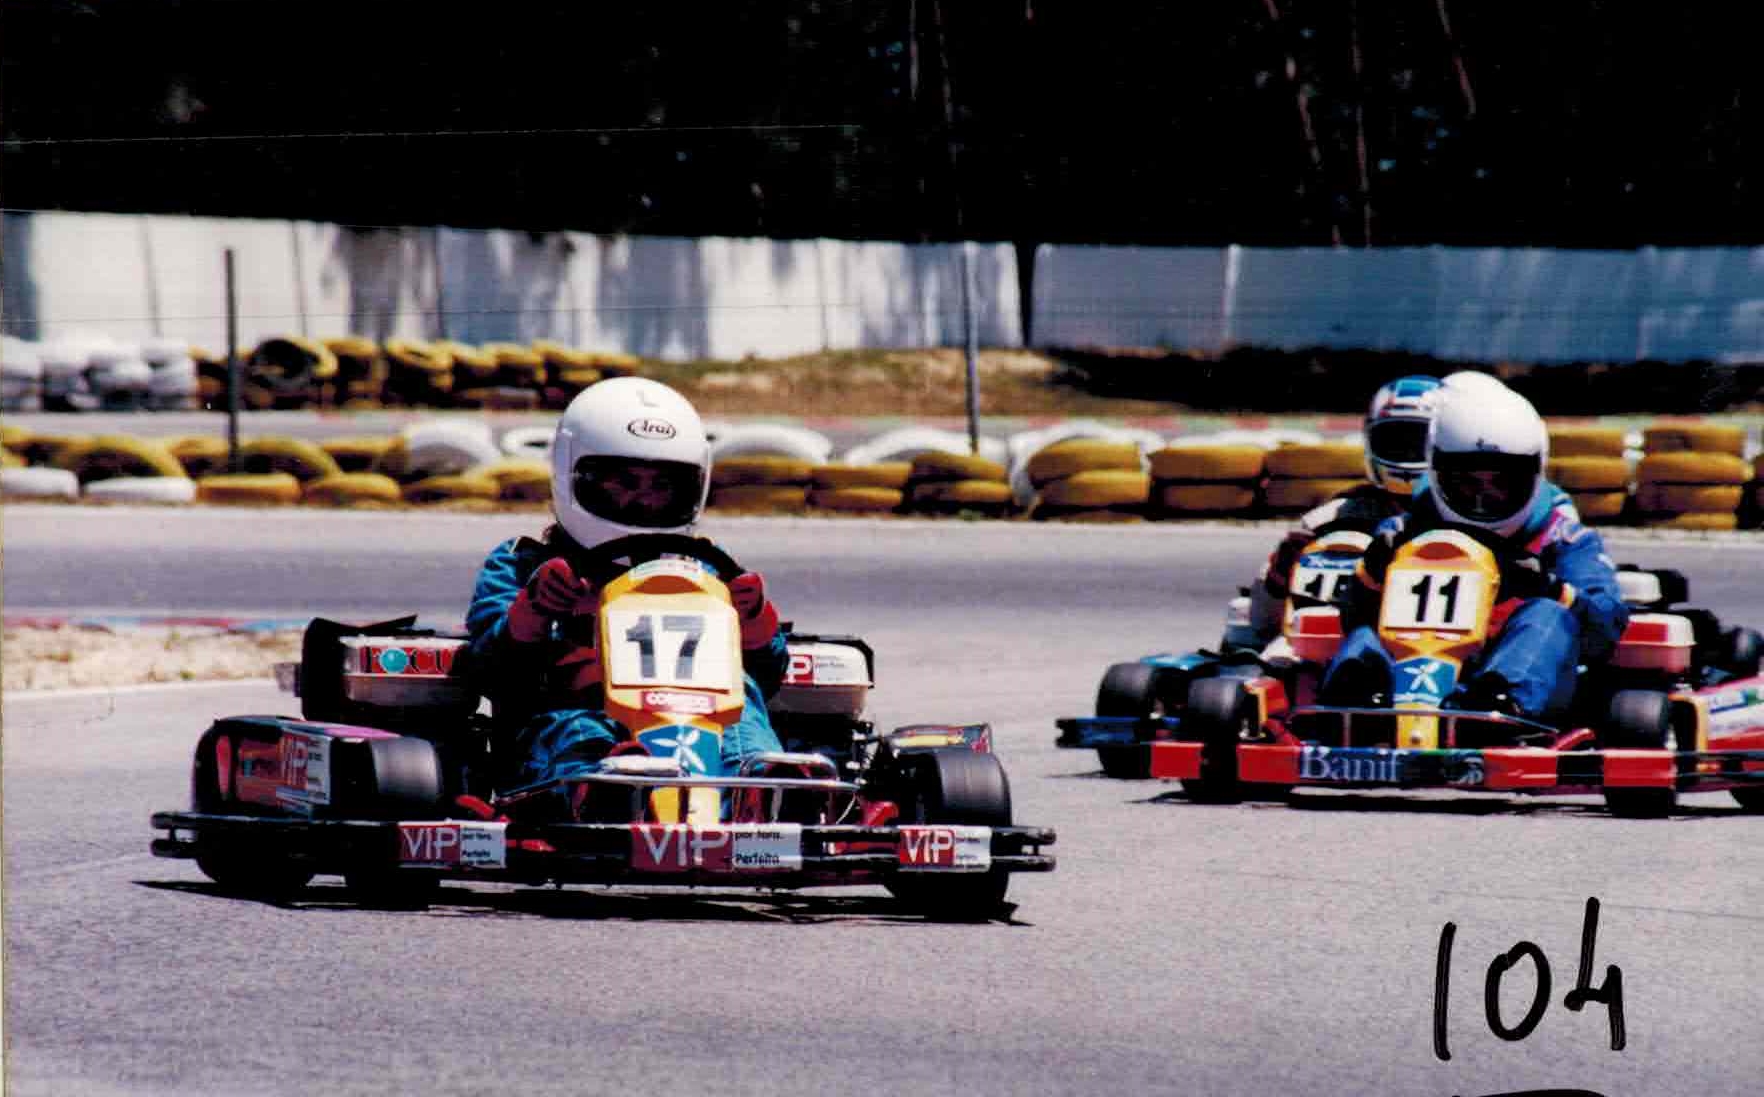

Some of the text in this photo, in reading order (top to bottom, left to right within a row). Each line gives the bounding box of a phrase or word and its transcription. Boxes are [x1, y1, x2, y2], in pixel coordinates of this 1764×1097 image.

[1411, 574, 1461, 624] 11
[625, 614, 705, 679] 17
[1300, 746, 1404, 782] Banif
[402, 827, 458, 860] VIP
[637, 826, 731, 867] VIP
[902, 829, 954, 864] VIP
